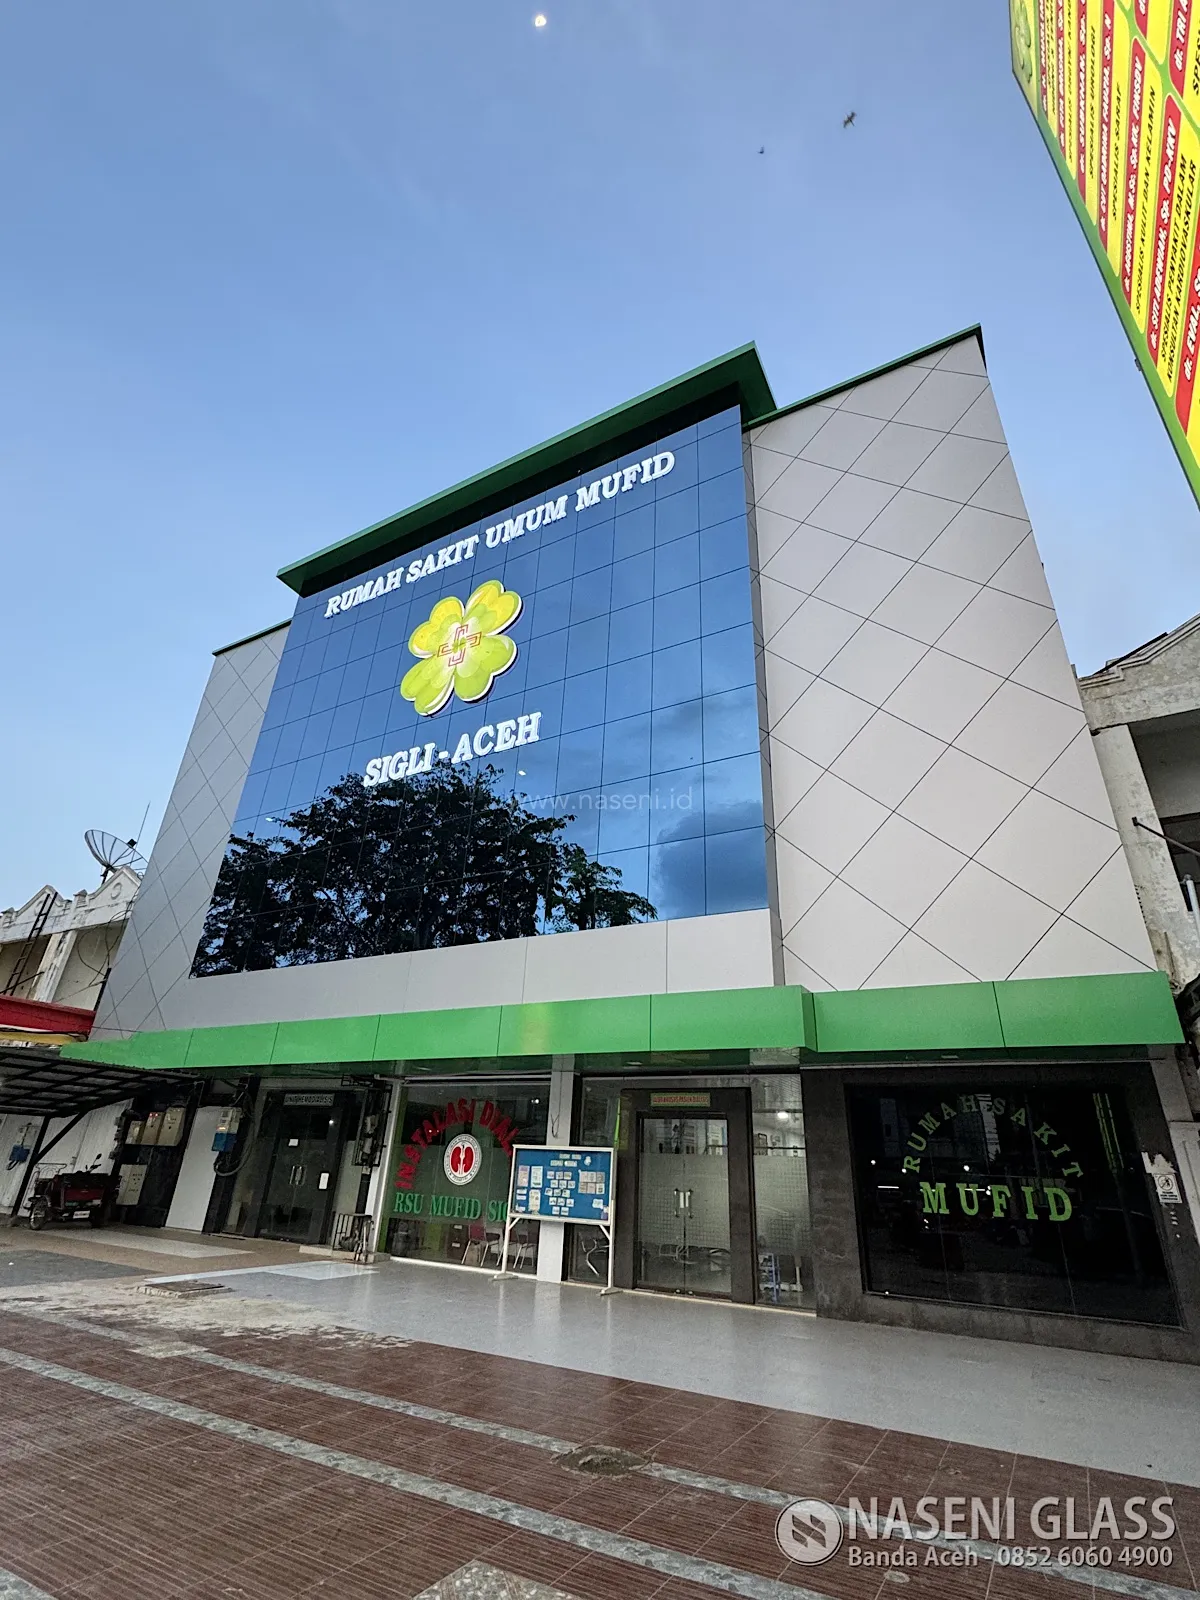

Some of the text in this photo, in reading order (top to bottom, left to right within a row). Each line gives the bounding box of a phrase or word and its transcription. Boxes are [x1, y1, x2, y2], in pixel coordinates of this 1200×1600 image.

[1173, 46, 1184, 72] dr.
[1175, 10, 1187, 44] TRI
[1135, 85, 1155, 315] SPESIALIS KULIT DAN KELAMIN
[1160, 153, 1187, 362] SPESIALIS PENYAKIT DALAM
[1166, 159, 1197, 382] KONSULTAN KARDIOVASKULAR
[1182, 355, 1194, 382] dr.
[323, 450, 676, 618] RUMAH SAKIT UMUM MUFID
[362, 743, 436, 788] SIGLI
[451, 711, 543, 764] ACEH
[903, 1095, 1084, 1179] RUMAH SAKIT
[393, 1191, 424, 1214] RSU
[429, 1194, 482, 1221] MUFID
[919, 1180, 1074, 1222] MUFID
